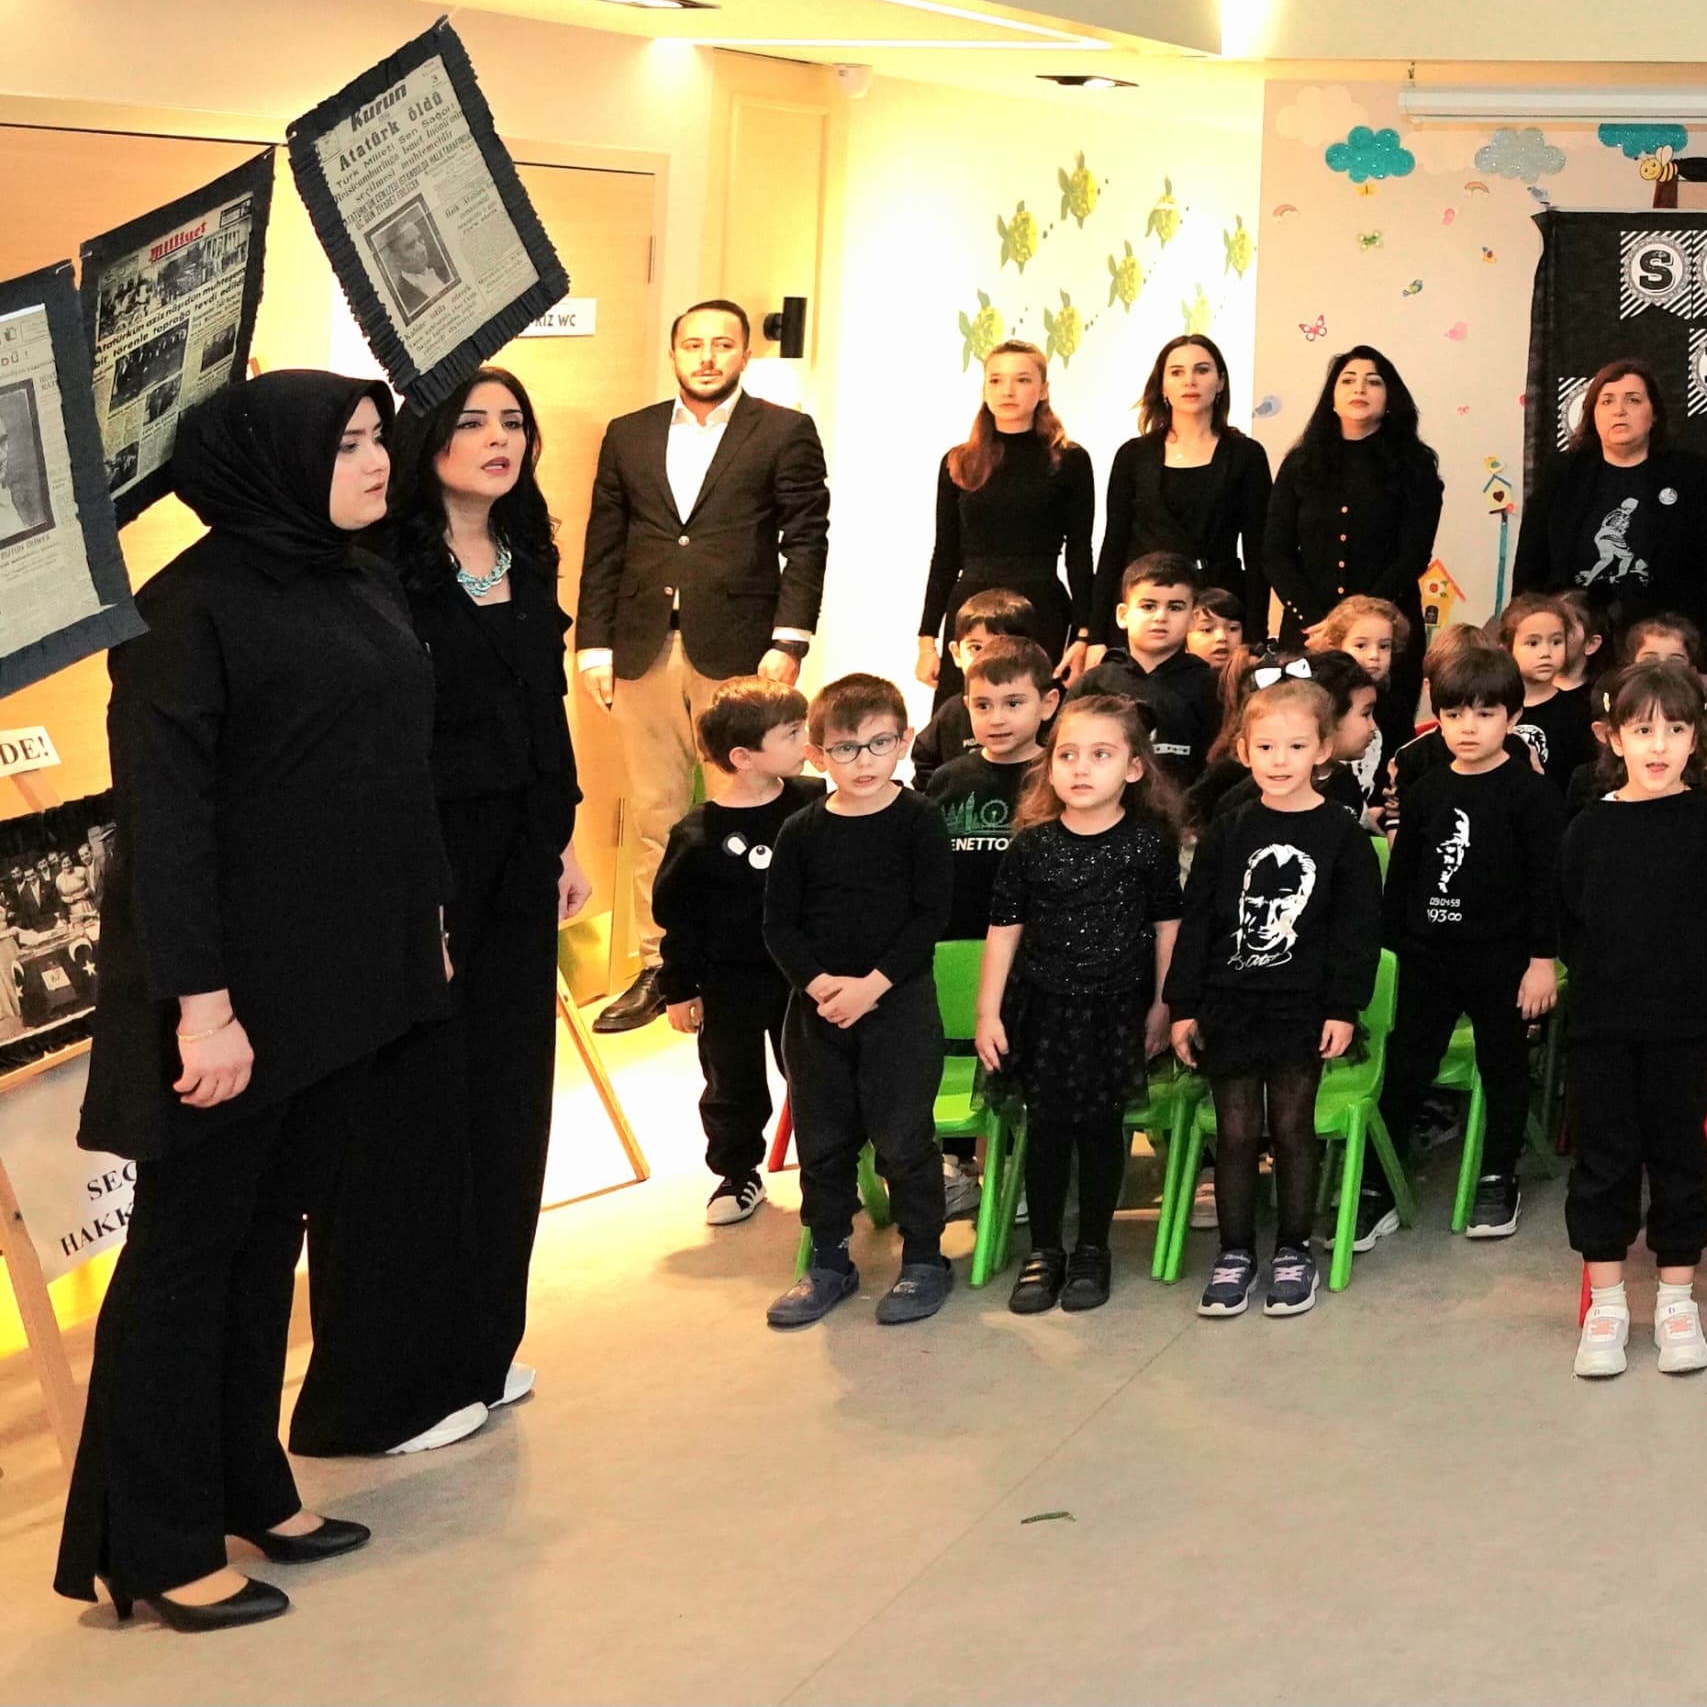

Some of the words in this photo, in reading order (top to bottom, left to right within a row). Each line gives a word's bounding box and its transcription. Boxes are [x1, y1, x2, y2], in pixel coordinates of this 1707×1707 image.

[339, 120, 401, 172] Atatürk
[407, 90, 444, 123] öldü
[557, 314, 576, 327] WC
[950, 835, 1014, 852] NETTO
